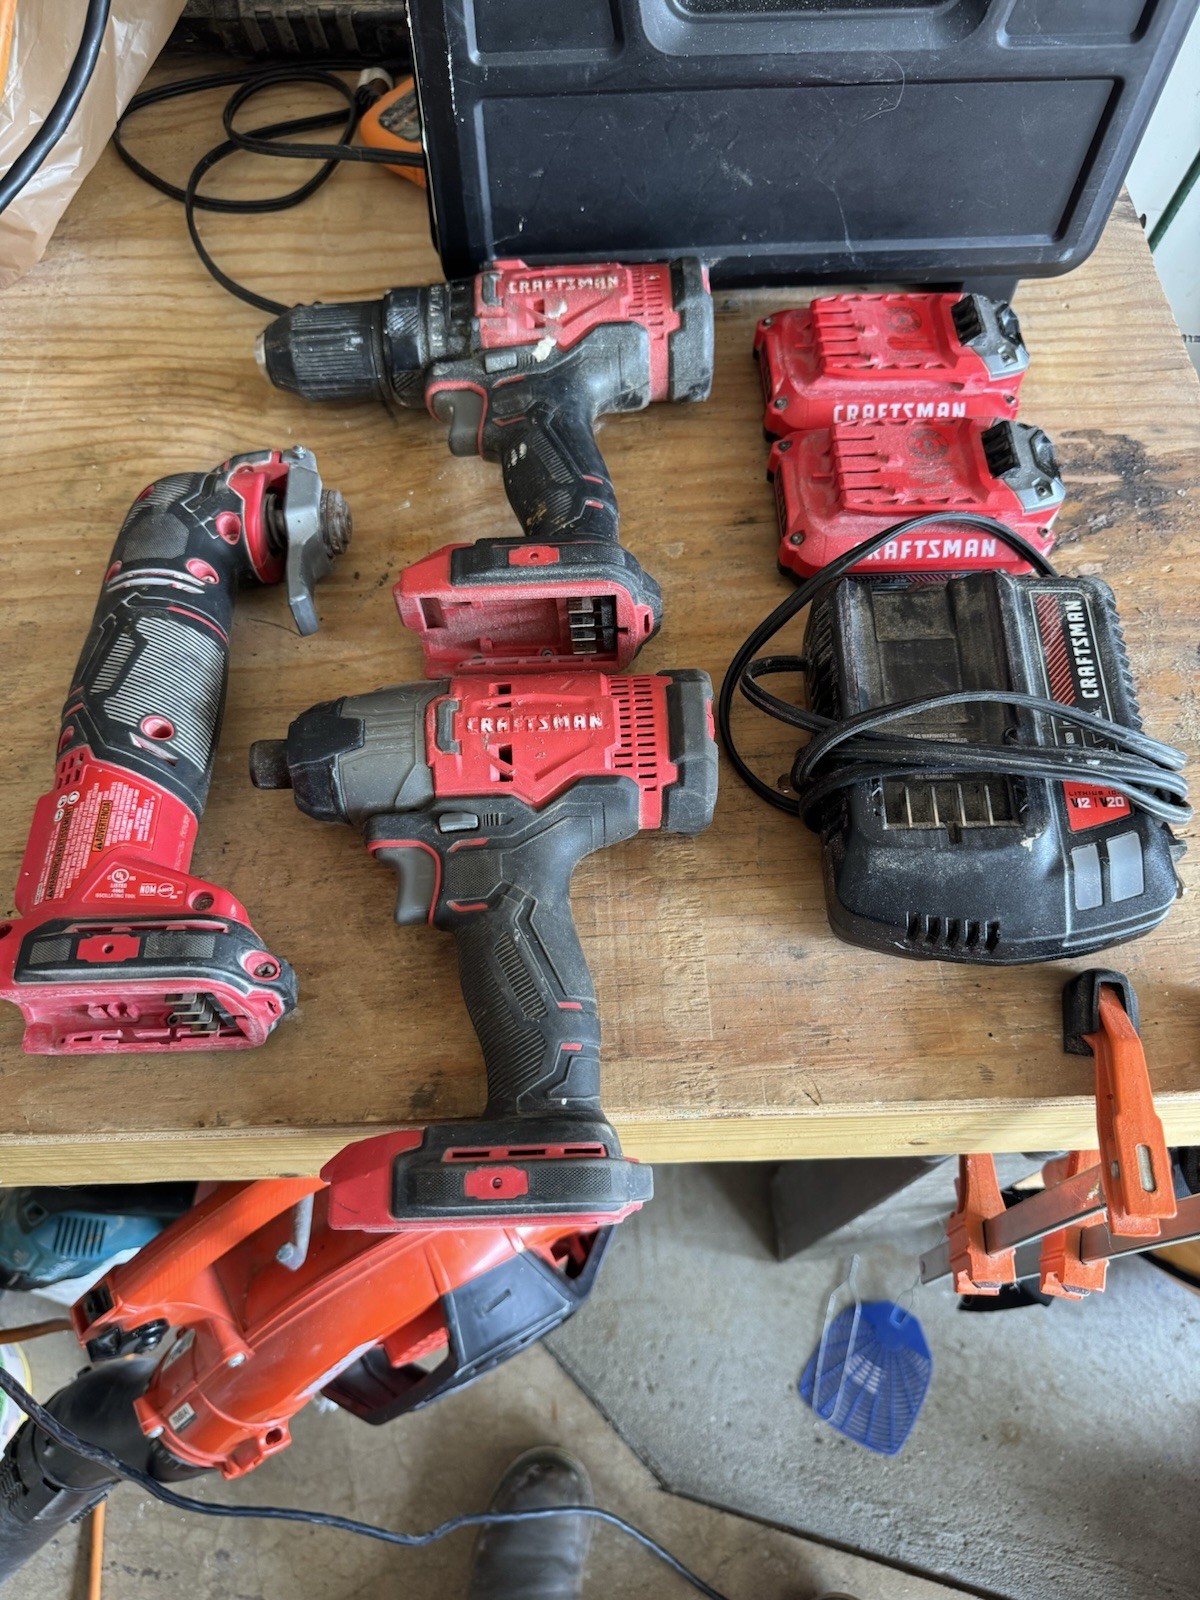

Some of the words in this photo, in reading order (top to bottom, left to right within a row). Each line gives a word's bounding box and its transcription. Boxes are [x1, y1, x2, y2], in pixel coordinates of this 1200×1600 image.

[508, 276, 618, 294] CRAFTSMAN
[832, 402, 966, 424] CRAFTSMAN
[853, 539, 996, 560] AFTSMAN
[1064, 600, 1100, 699] CRAFTSMAN
[467, 712, 603, 734] CRAFTSMAN
[96, 801, 112, 845] ADVERTENCIA
[140, 884, 157, 895] NOM
